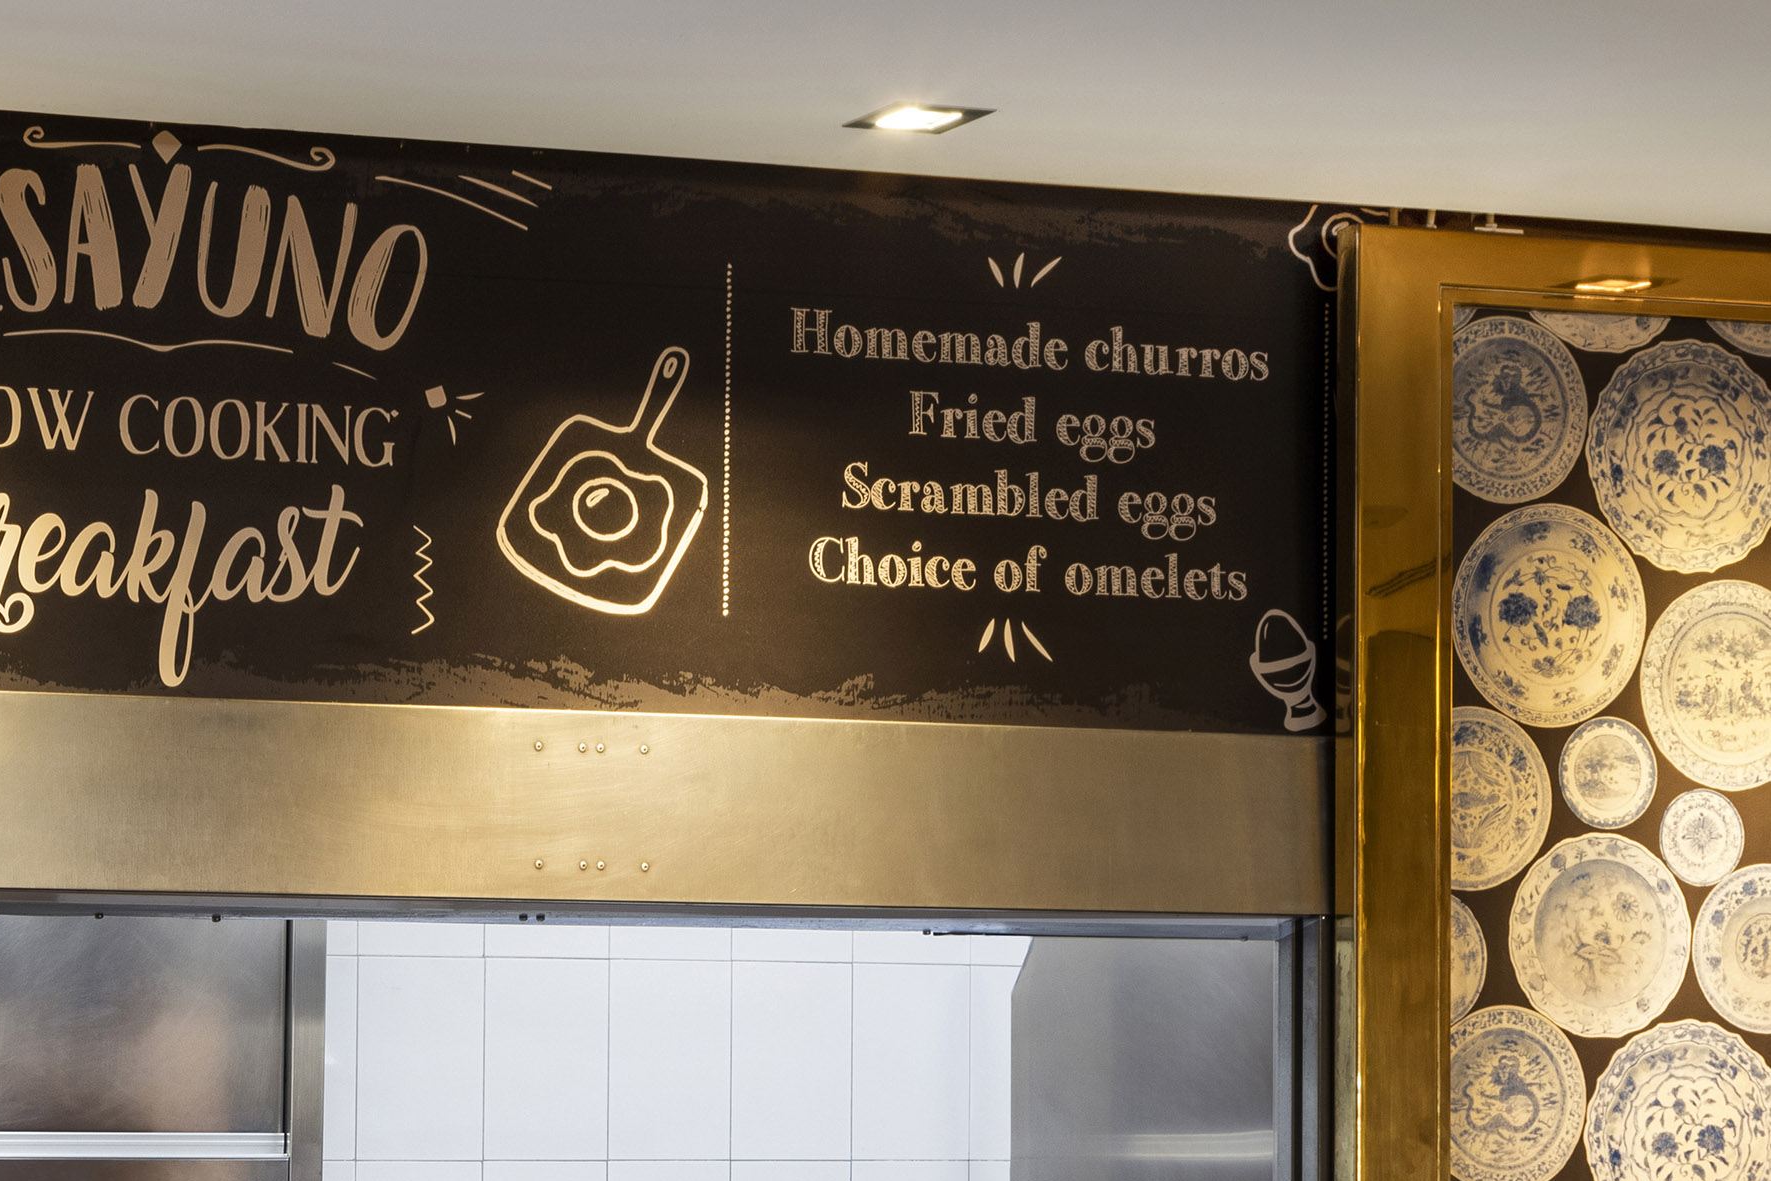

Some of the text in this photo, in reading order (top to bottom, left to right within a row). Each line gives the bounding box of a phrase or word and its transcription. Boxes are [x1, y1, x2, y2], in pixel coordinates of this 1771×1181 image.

[791, 307, 1270, 382] Homemade churros
[120, 394, 400, 468] COOKING
[908, 390, 1156, 464] Fried eggs
[842, 461, 1217, 542] Scrambled eggs
[808, 536, 1248, 602] Choice of omelets
